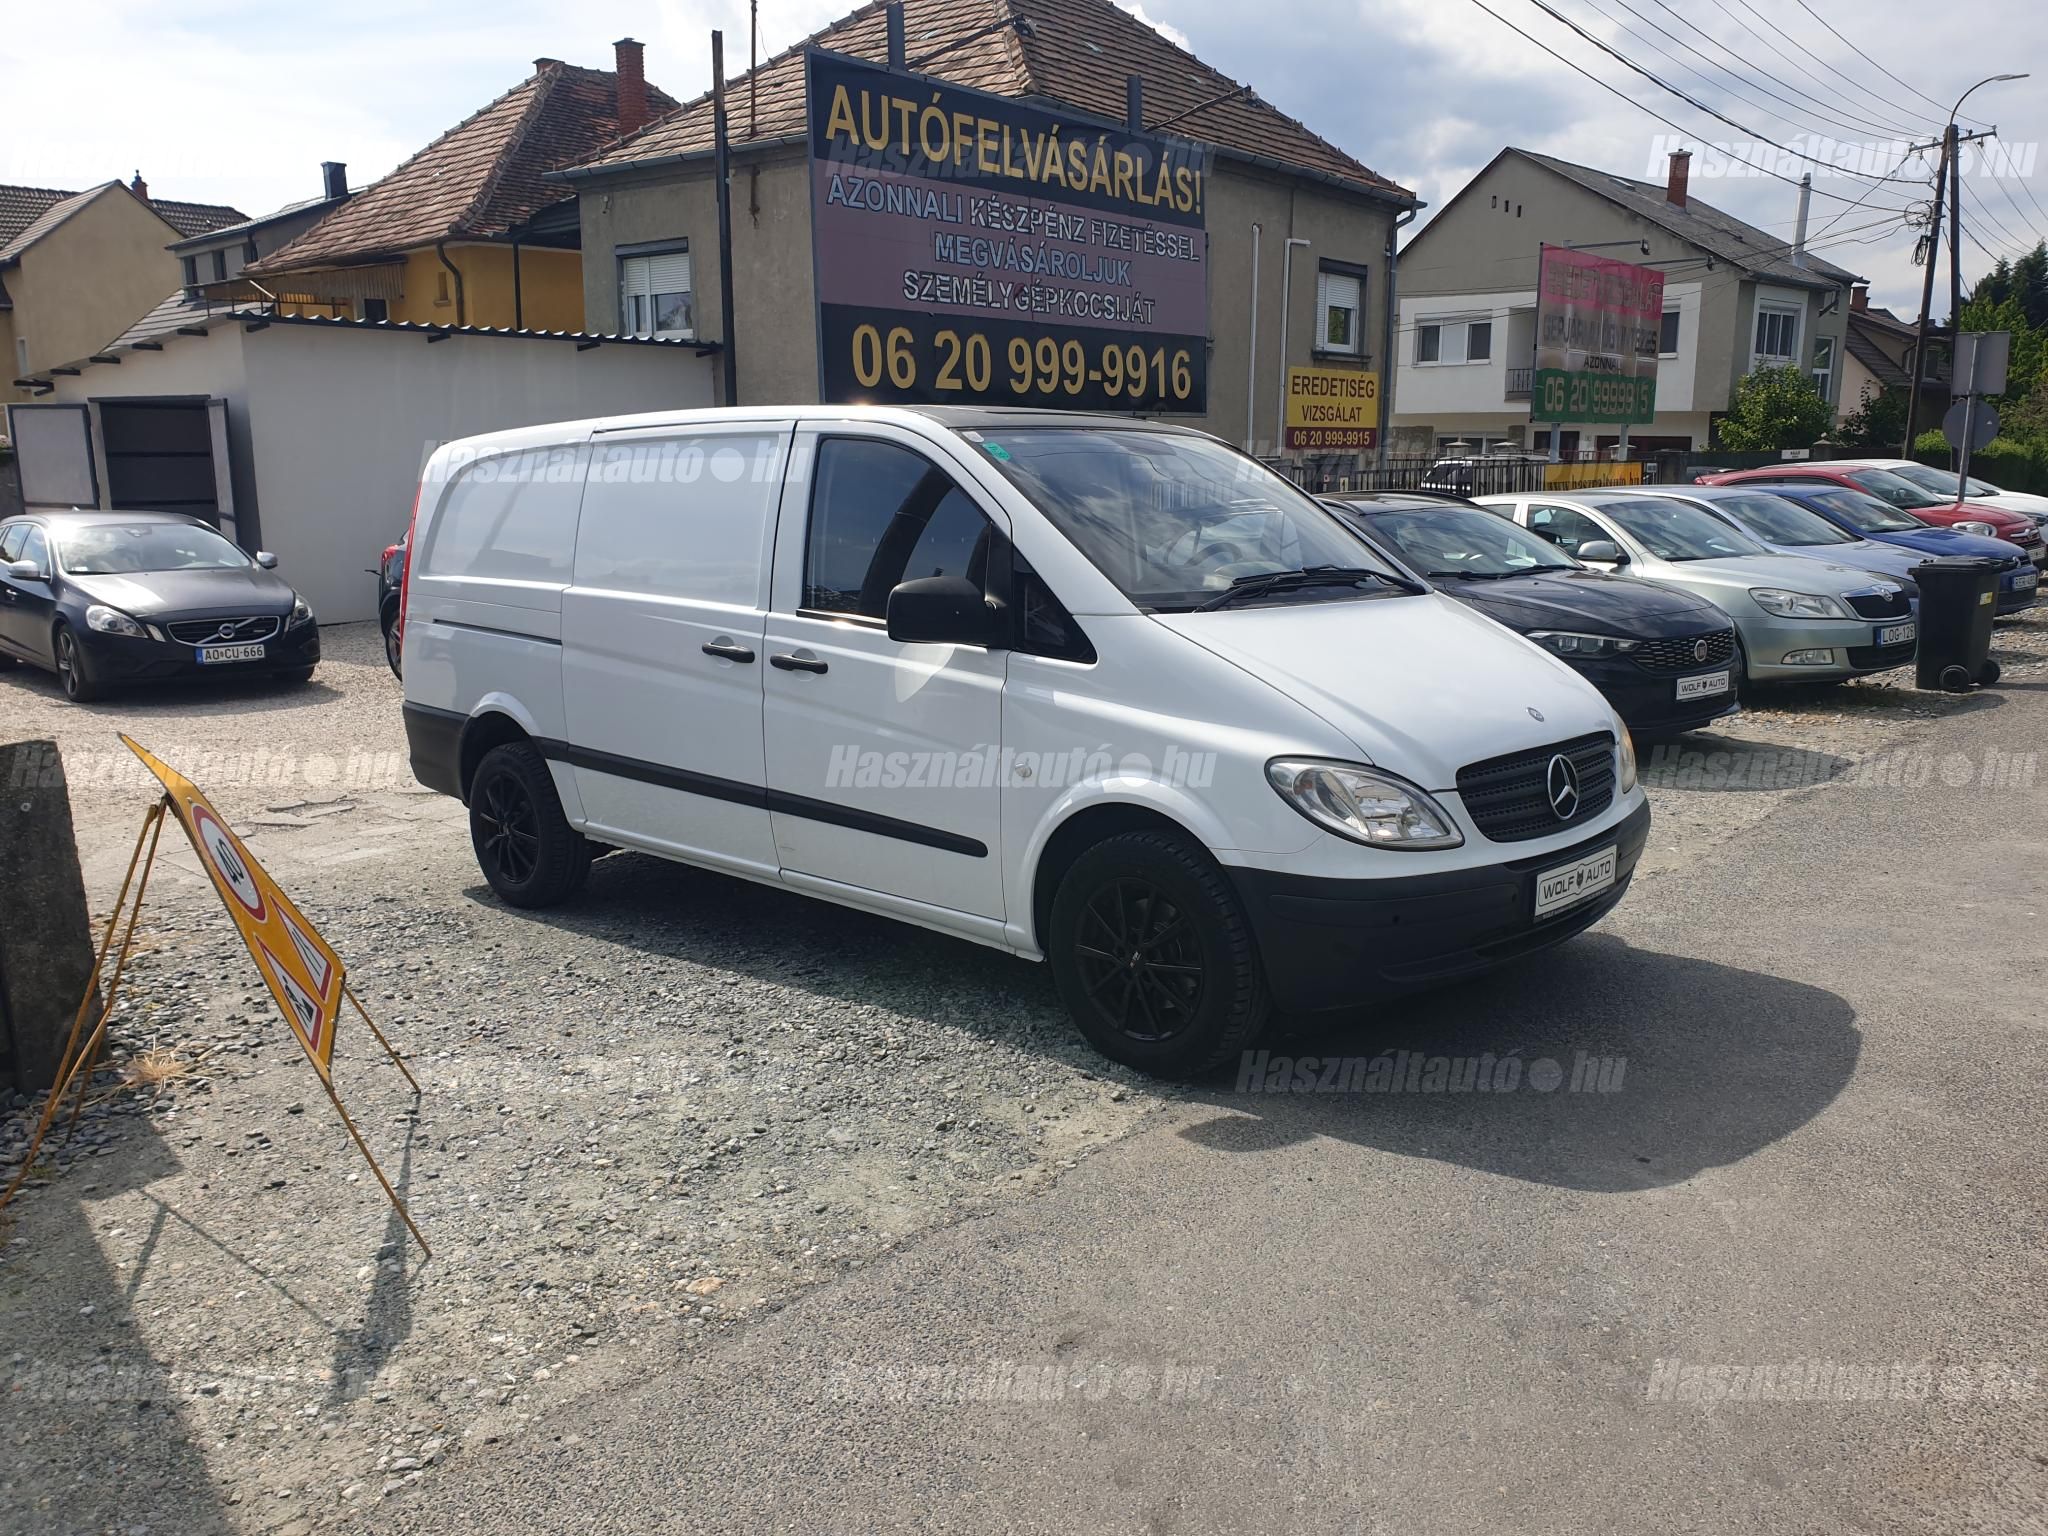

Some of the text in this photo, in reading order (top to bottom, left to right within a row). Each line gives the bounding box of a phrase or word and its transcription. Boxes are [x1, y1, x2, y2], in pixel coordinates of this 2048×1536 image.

[825, 84, 1201, 214] AUTÓFELVÁSÁRLÁS!
[826, 174, 1200, 261] AZONNALI KÉSZPÉNZ FIZETÉSSEL
[935, 232, 1132, 287] MEGVÁSÁROLJUK
[903, 271, 1155, 324] SZEMÉLYGÉPKOCSIJÁT
[852, 324, 1191, 400] 06 20 999-9916
[1292, 374, 1375, 398] EREDETISÉG
[1544, 376, 1565, 412] 06
[1569, 378, 1588, 413] 20
[1302, 402, 1362, 422] VIZSGÁLAT
[1294, 431, 1370, 445] 06 20 999-9915
[224, 646, 263, 660] CU-666
[1681, 678, 1726, 692] WOLF AUTO
[215, 838, 245, 885] 40
[1543, 860, 1611, 900] WOLF AUTO
